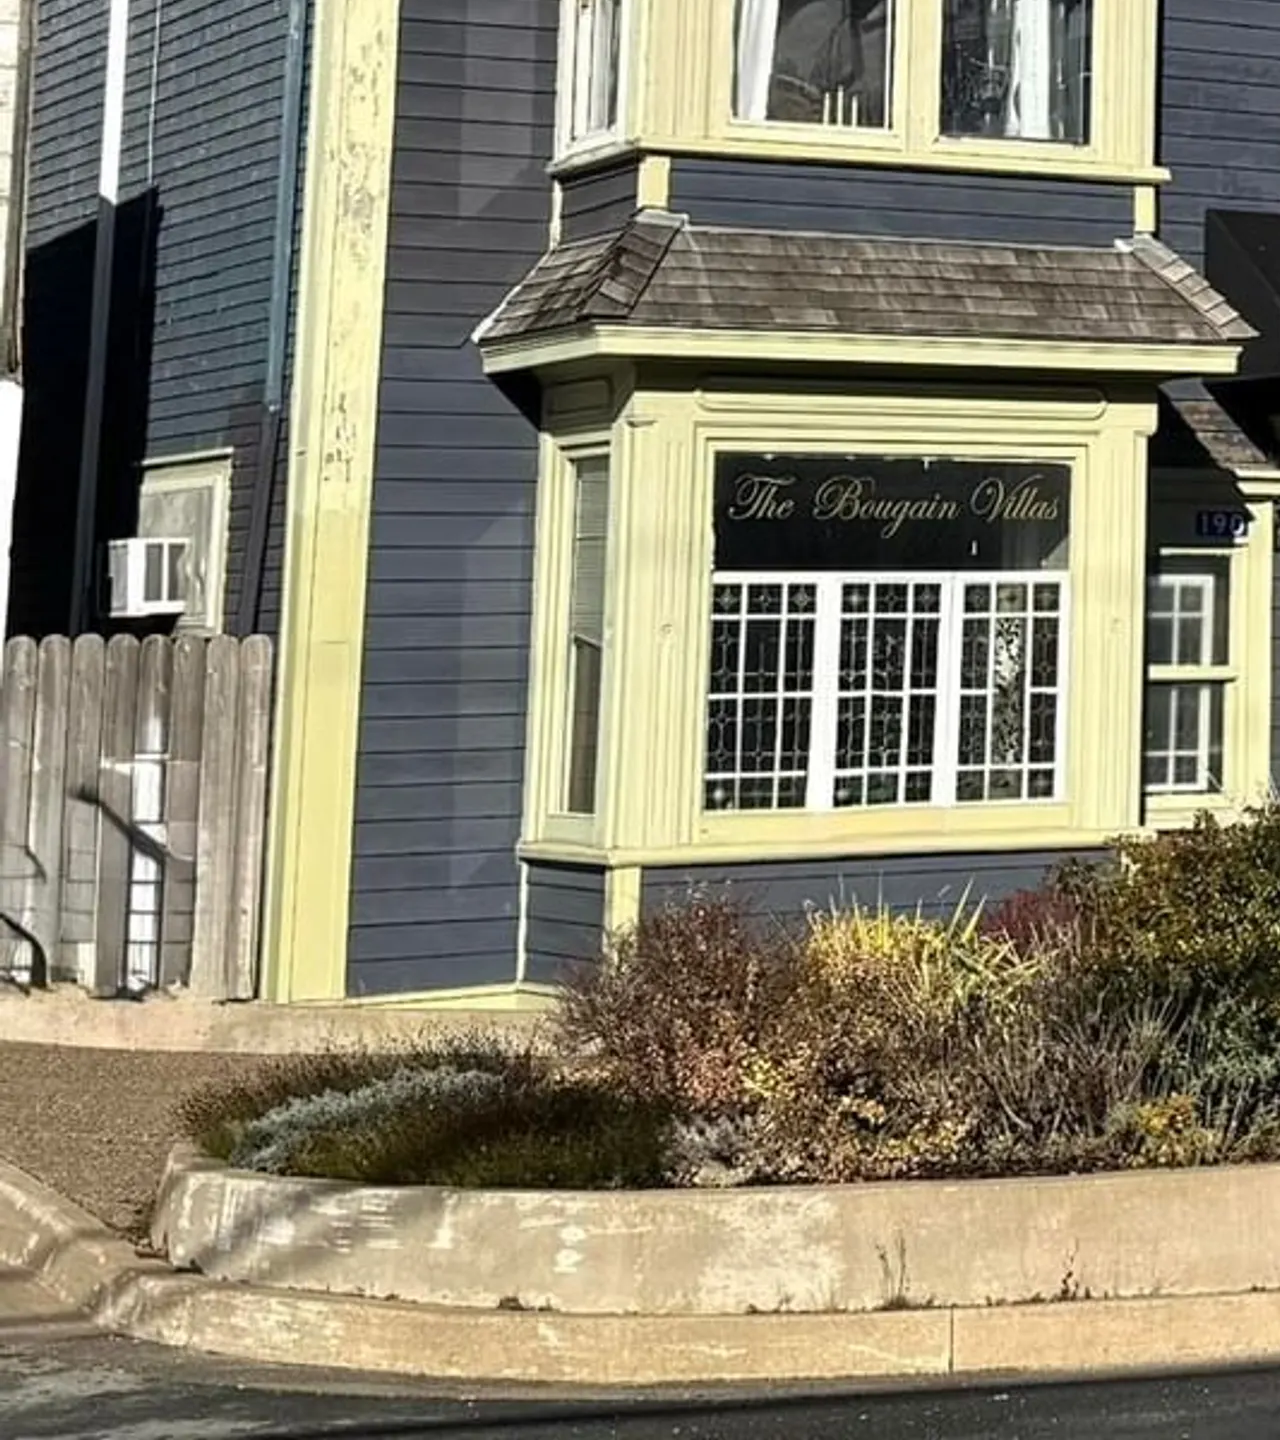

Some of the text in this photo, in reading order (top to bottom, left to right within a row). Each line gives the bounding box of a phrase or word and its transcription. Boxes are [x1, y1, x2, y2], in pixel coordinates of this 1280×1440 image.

[729, 473, 1060, 539] The Bougain Villas
